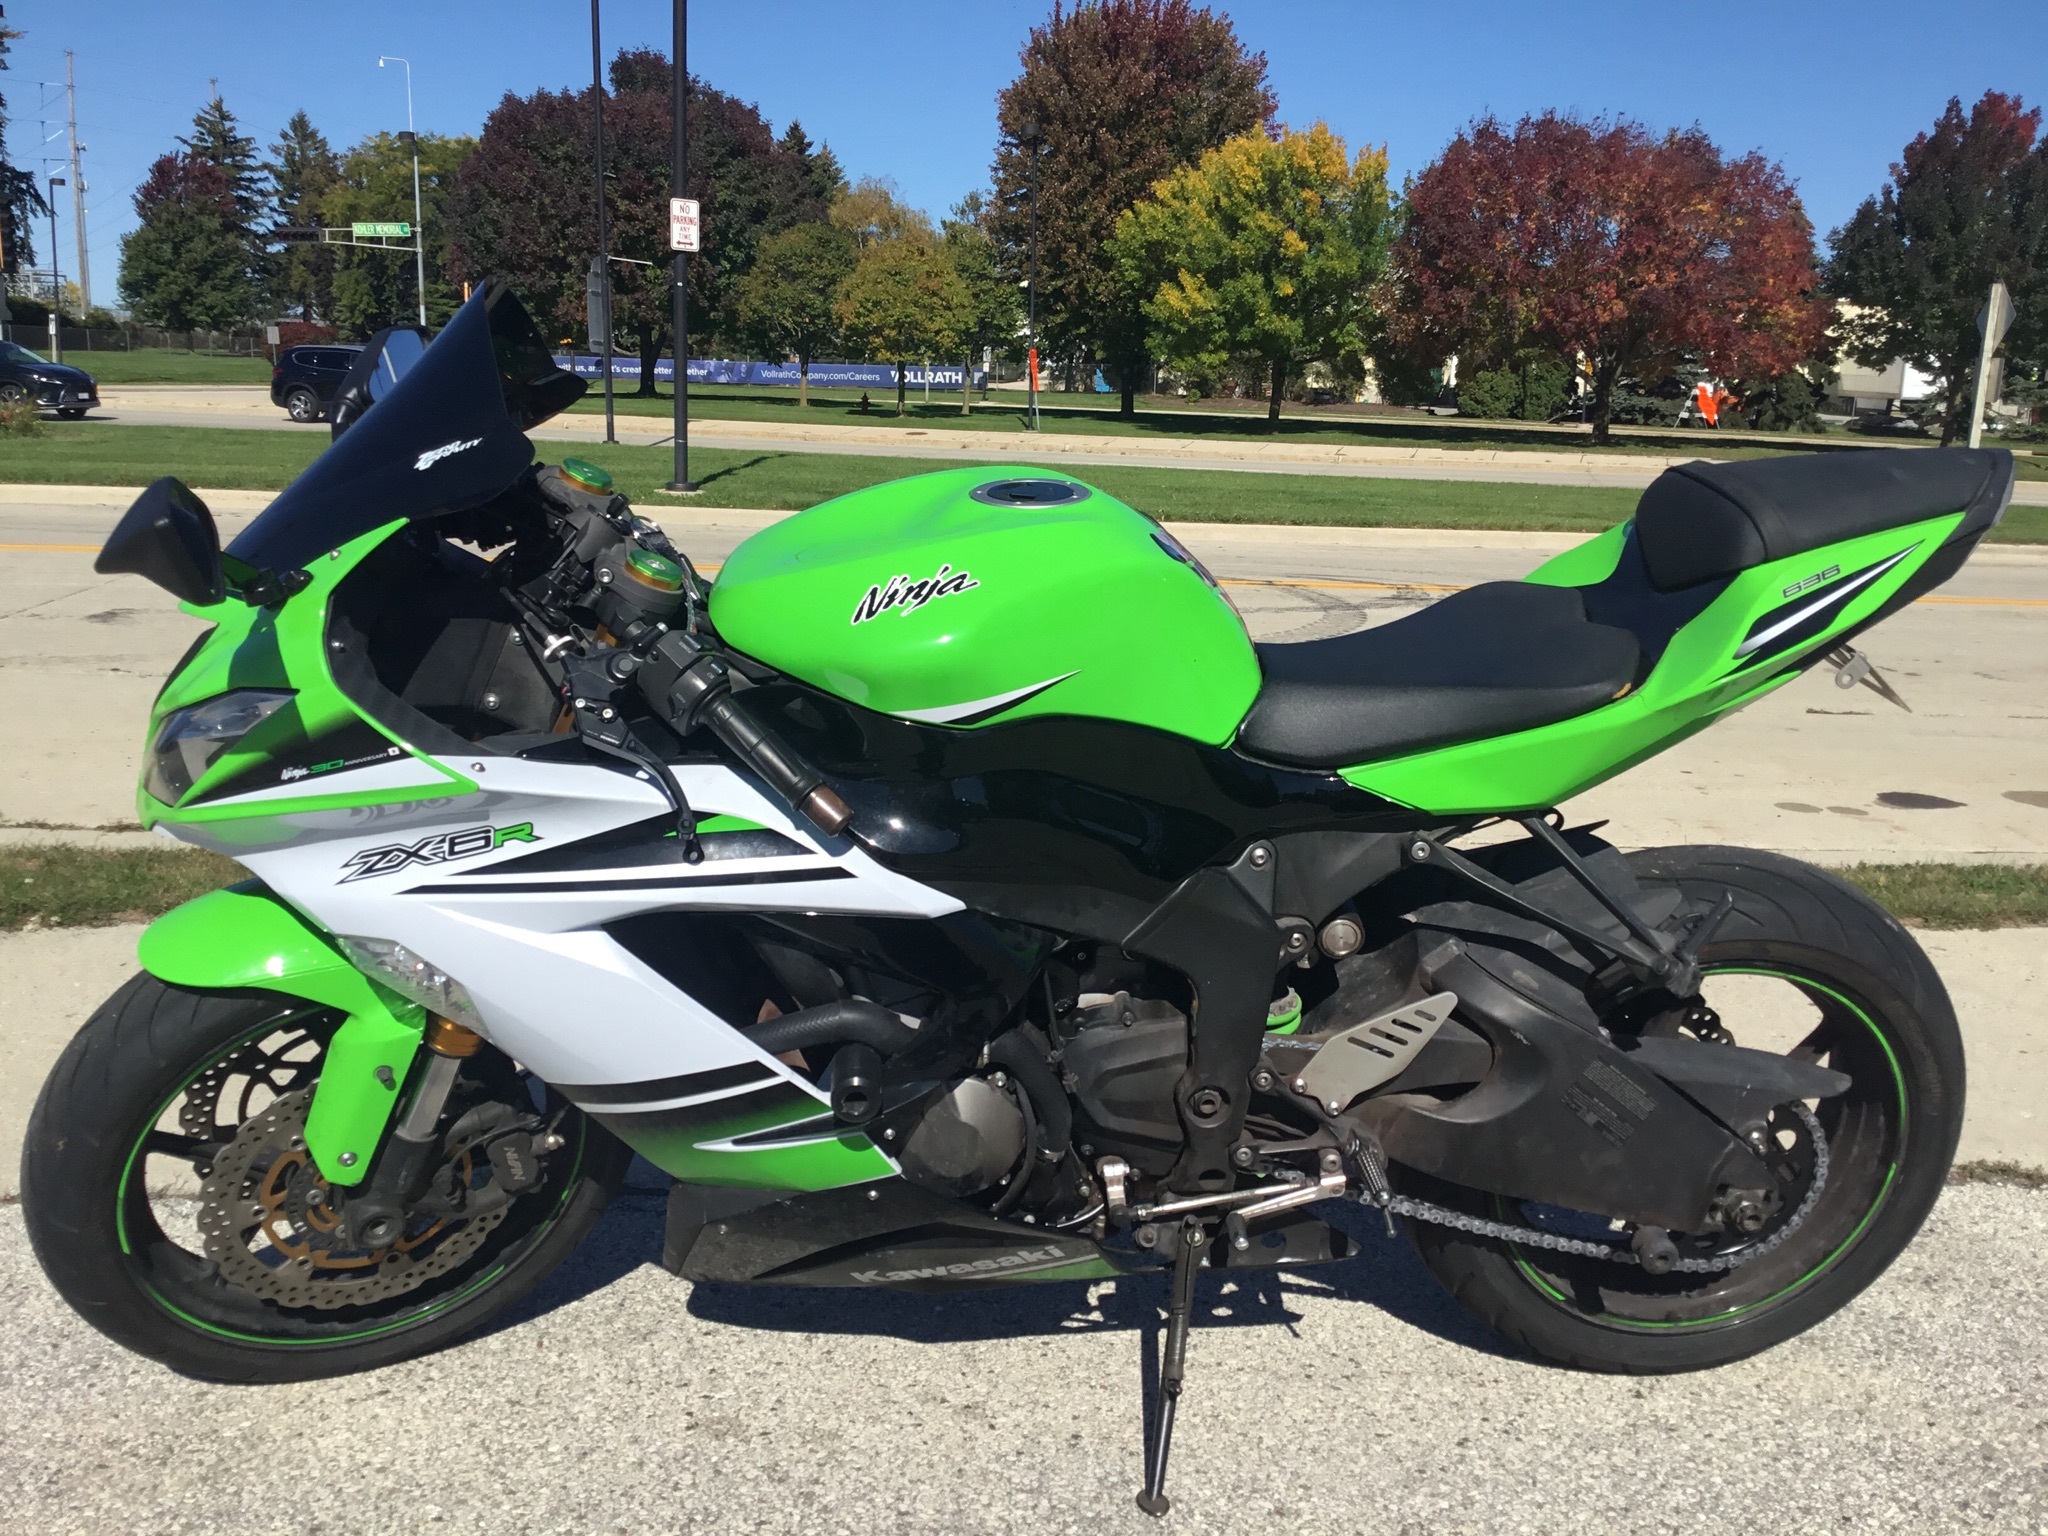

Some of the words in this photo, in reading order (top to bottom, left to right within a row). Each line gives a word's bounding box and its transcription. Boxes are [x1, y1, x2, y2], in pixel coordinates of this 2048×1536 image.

[679, 204, 690, 214] NO
[672, 215, 697, 226] PARKING
[354, 224, 375, 235] KOHLER
[375, 224, 403, 235] MEMORIAL
[574, 364, 587, 373] us,
[653, 367, 673, 375] etter
[760, 369, 881, 382] VollrathCopany.com/Careers
[1782, 563, 1841, 599] 636
[850, 563, 980, 626] Ninja
[280, 765, 310, 781] Ninja
[344, 752, 388, 766] ANNIVERSARY
[850, 1245, 1067, 1283] Kawasaki
